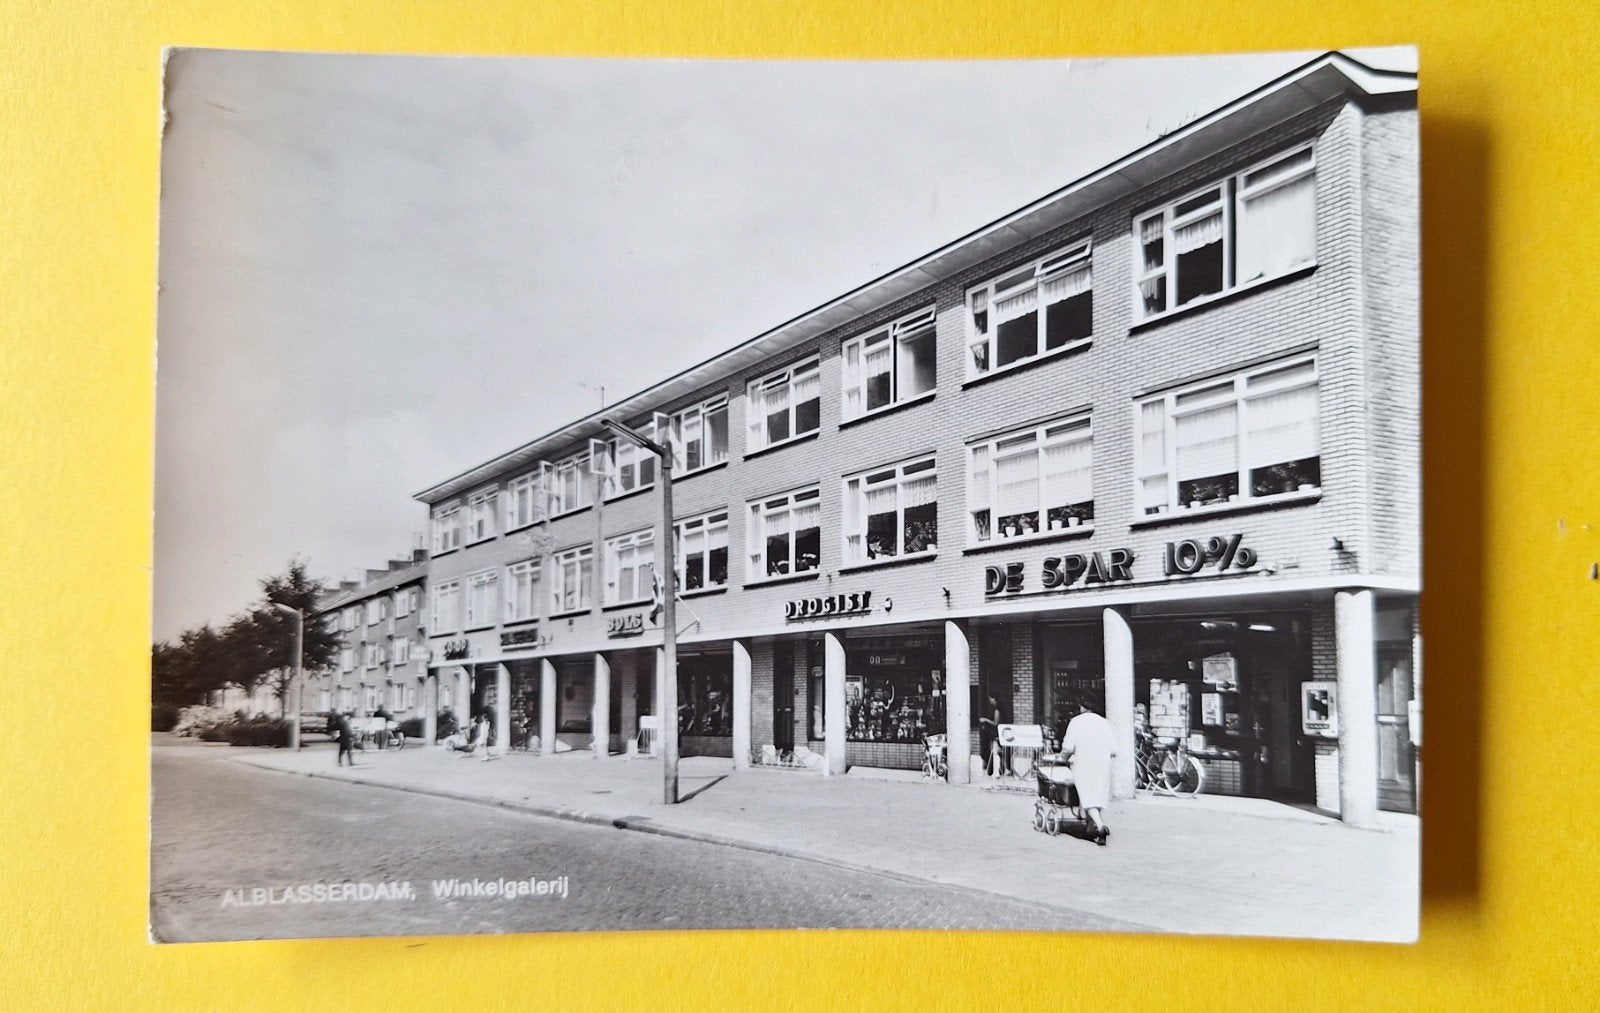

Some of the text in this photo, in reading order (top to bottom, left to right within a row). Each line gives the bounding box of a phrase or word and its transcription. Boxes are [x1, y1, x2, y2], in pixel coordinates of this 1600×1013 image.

[984, 533, 1258, 595] DE SPAR 10%
[785, 591, 872, 618] DROGIST
